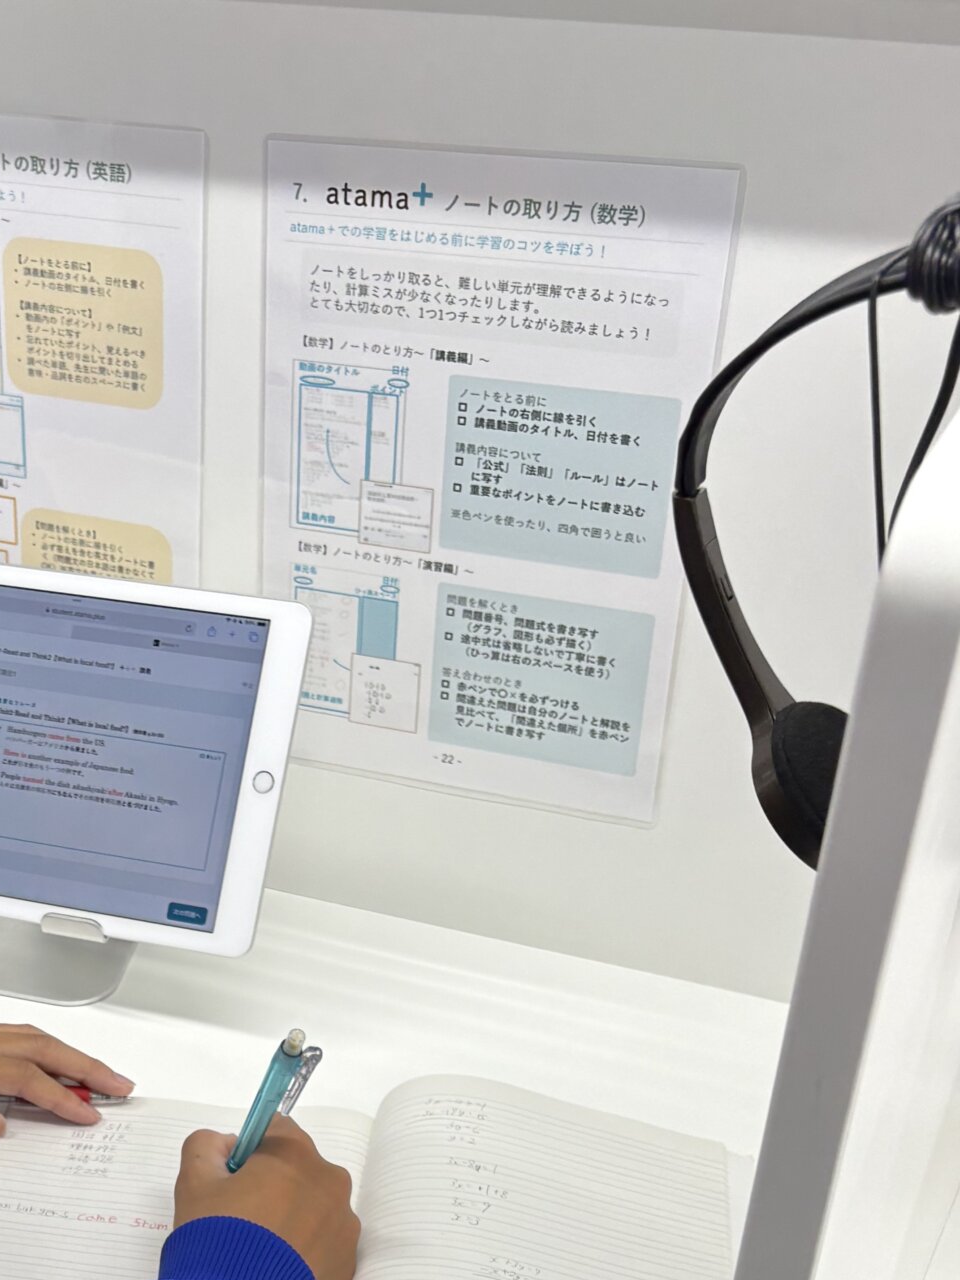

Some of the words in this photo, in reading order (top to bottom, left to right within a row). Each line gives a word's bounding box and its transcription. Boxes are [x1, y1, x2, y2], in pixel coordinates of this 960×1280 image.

[293, 182, 308, 203] 7.
[326, 182, 434, 210] atama+
[309, 280, 540, 315] たり、計算ミスが少なくなったりします。
[391, 365, 410, 377] 日付
[459, 388, 547, 408] ノートをとる前に
[476, 403, 597, 428] ノートの右側に線を引く
[474, 416, 641, 447] 講義動画のタイトル、日付を書く
[455, 441, 542, 463] 講義内容について
[471, 471, 503, 485] に写す
[469, 484, 646, 518] 重要なポイントをノートに書き込む
[462, 609, 600, 640] 問題番号、問題式を書き写す
[460, 634, 616, 668] 途中式は省略しないで丁寧に書く
[454, 717, 546, 741] でノートに書き写す
[441, 753, 454, 765] 22
